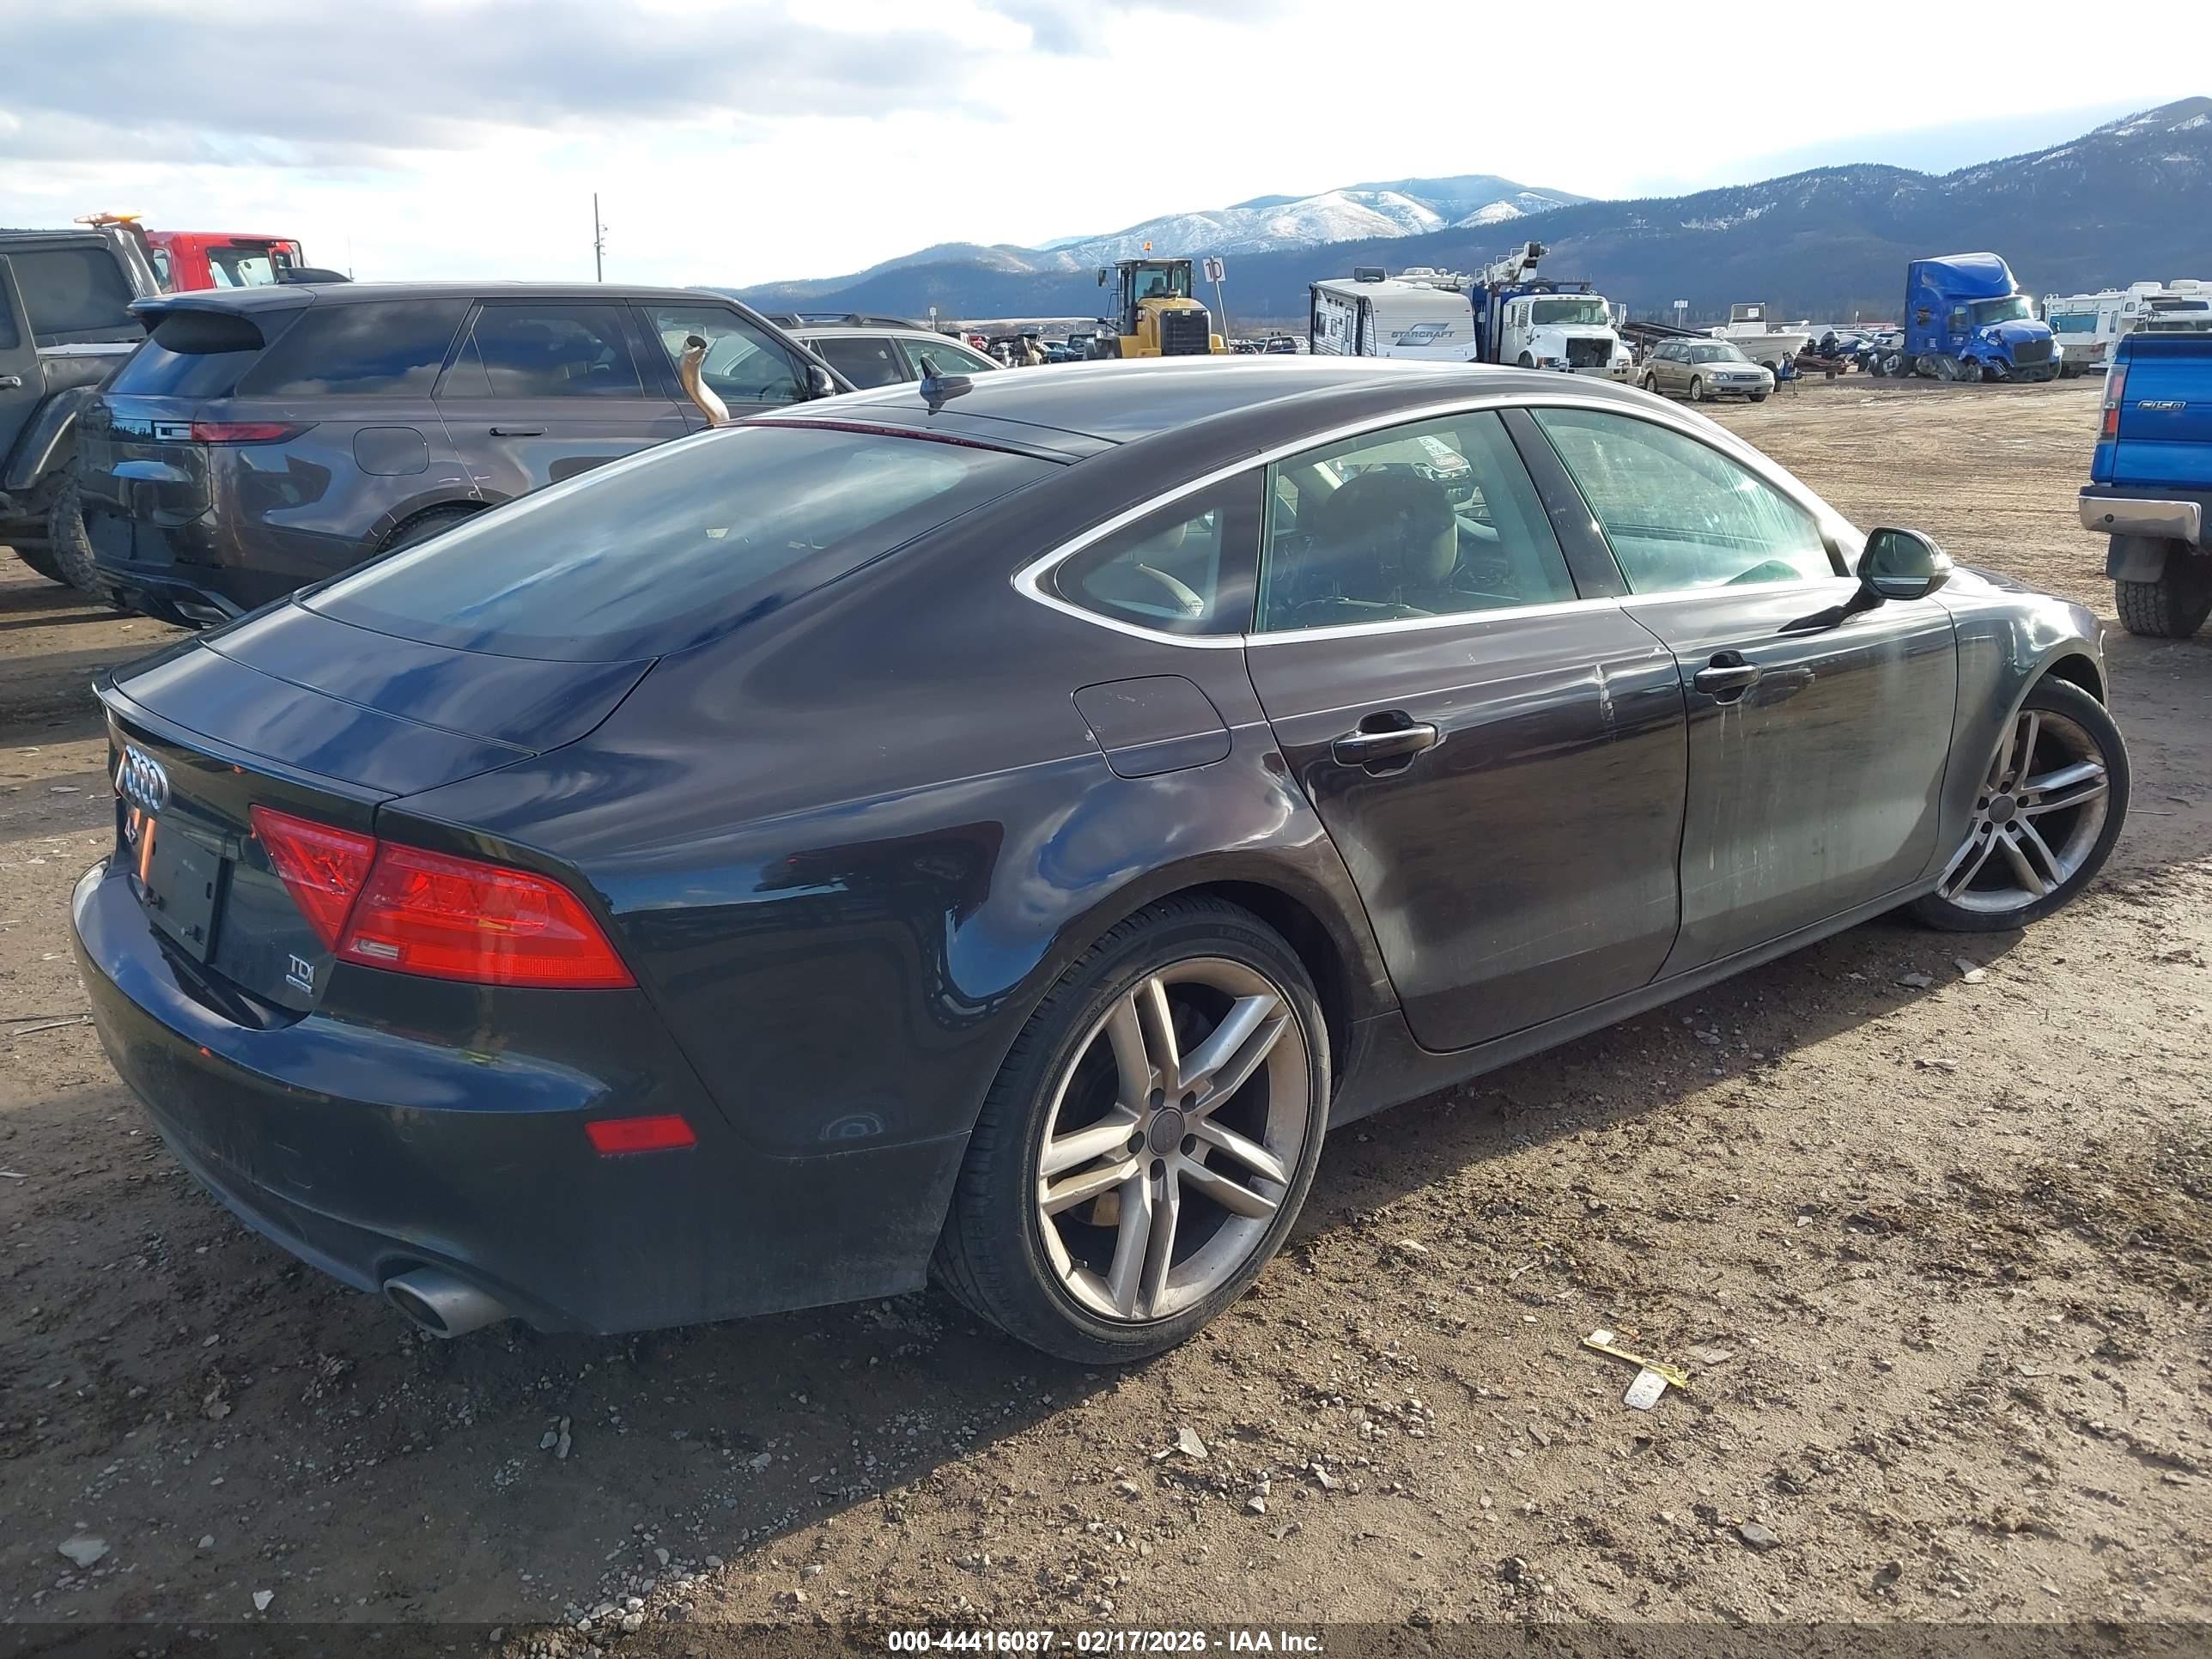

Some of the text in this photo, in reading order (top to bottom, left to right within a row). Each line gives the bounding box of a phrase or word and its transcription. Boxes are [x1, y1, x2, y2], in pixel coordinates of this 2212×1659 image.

[1205, 261, 1223, 279] 10
[2137, 400, 2187, 411] F150
[288, 953, 315, 983] TDI
